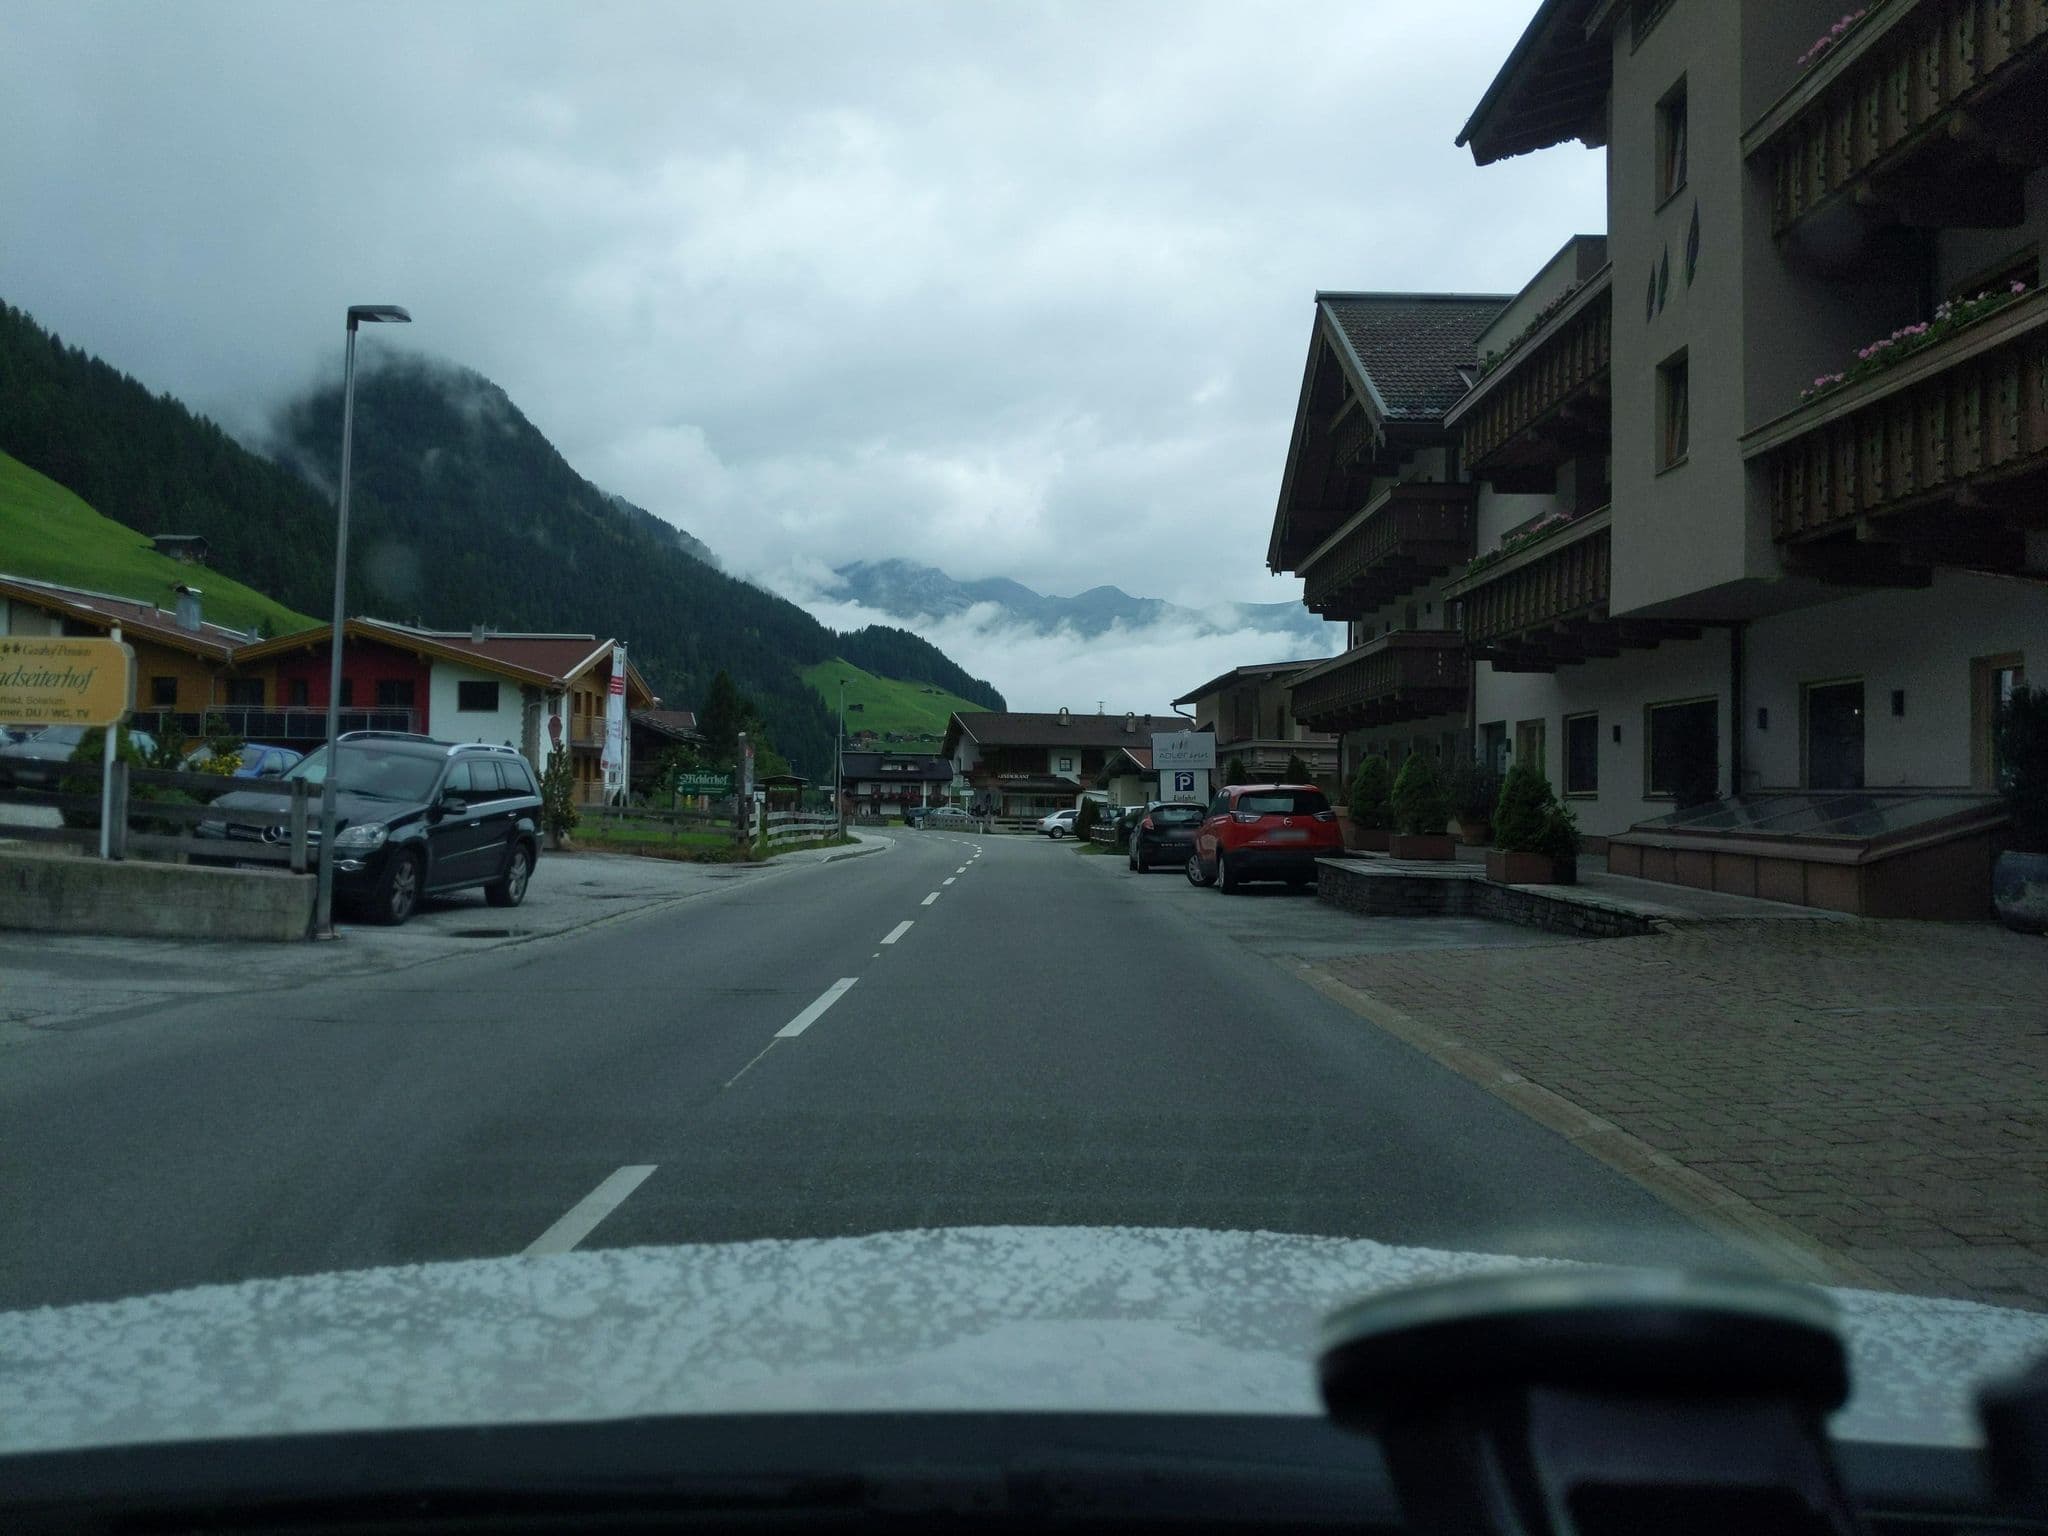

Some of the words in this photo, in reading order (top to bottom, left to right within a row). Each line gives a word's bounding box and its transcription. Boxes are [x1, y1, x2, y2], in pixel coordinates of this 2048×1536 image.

[23, 644, 59, 658] Gasthof
[76, 709, 89, 718] TV
[1180, 776, 1191, 790] P
